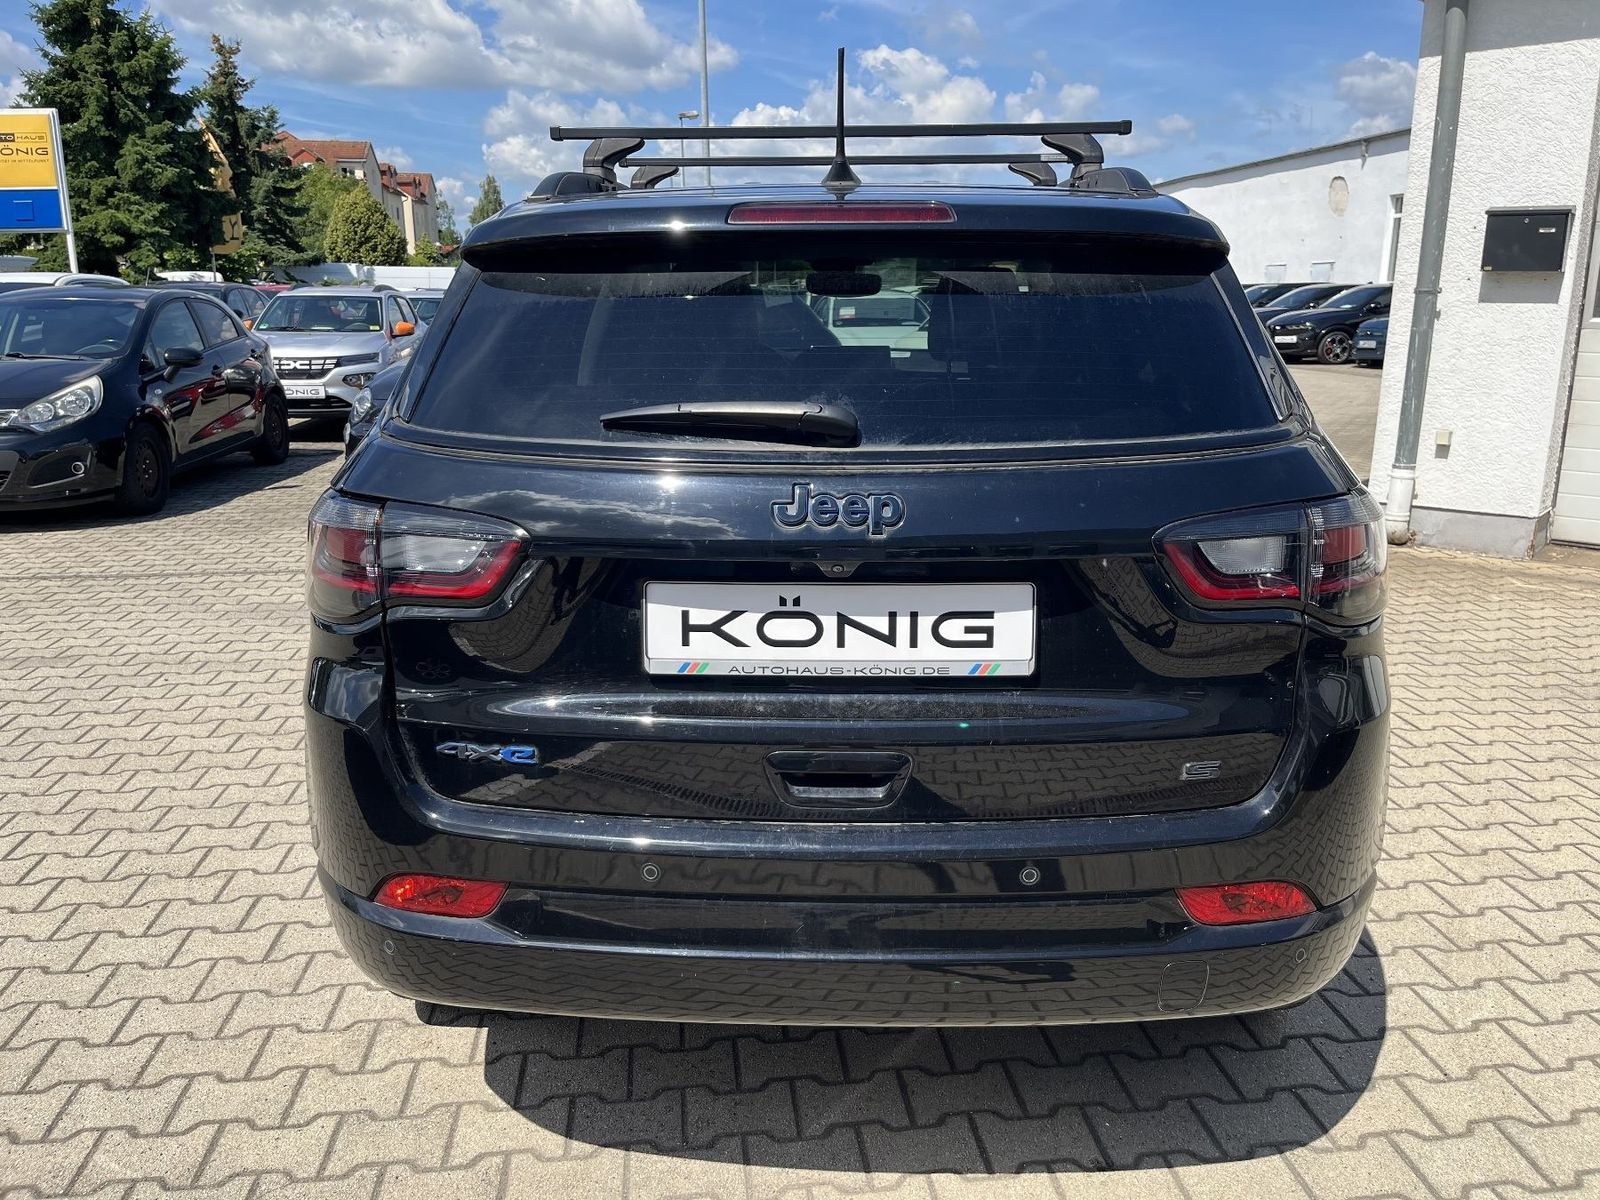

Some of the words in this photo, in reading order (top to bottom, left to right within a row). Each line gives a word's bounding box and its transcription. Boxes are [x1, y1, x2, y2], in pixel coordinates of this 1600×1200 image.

[770, 482, 907, 538] Jeep
[681, 595, 994, 648] KÖNIG
[728, 664, 950, 675] AUTOHAUS-KÖNIG.DE
